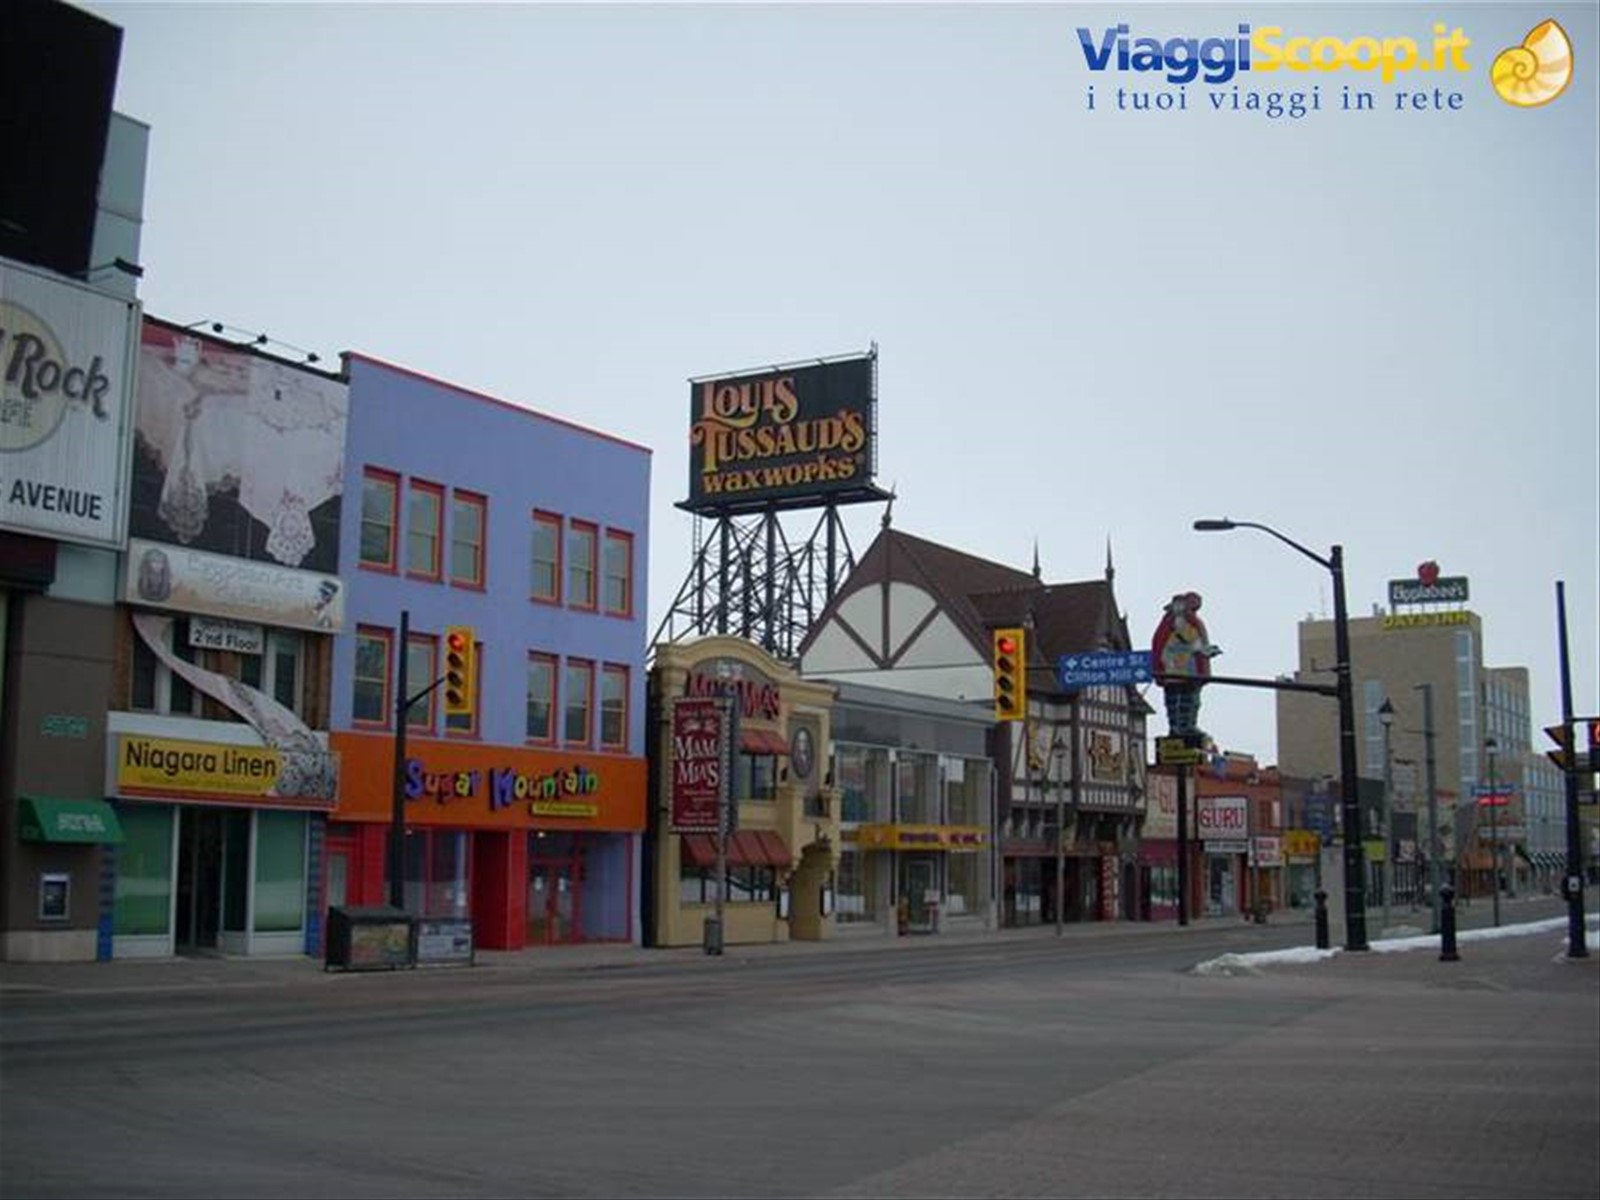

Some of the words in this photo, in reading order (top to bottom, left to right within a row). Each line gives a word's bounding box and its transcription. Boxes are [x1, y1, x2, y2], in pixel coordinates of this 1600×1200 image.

[5, 333, 109, 421] Rock
[9, 479, 102, 520] AVENUE
[126, 740, 217, 777] Niagara
[223, 749, 277, 778] Linen
[406, 758, 483, 804] Sugar
[490, 764, 599, 812] Mountain
[1200, 806, 1245, 830] GURU
